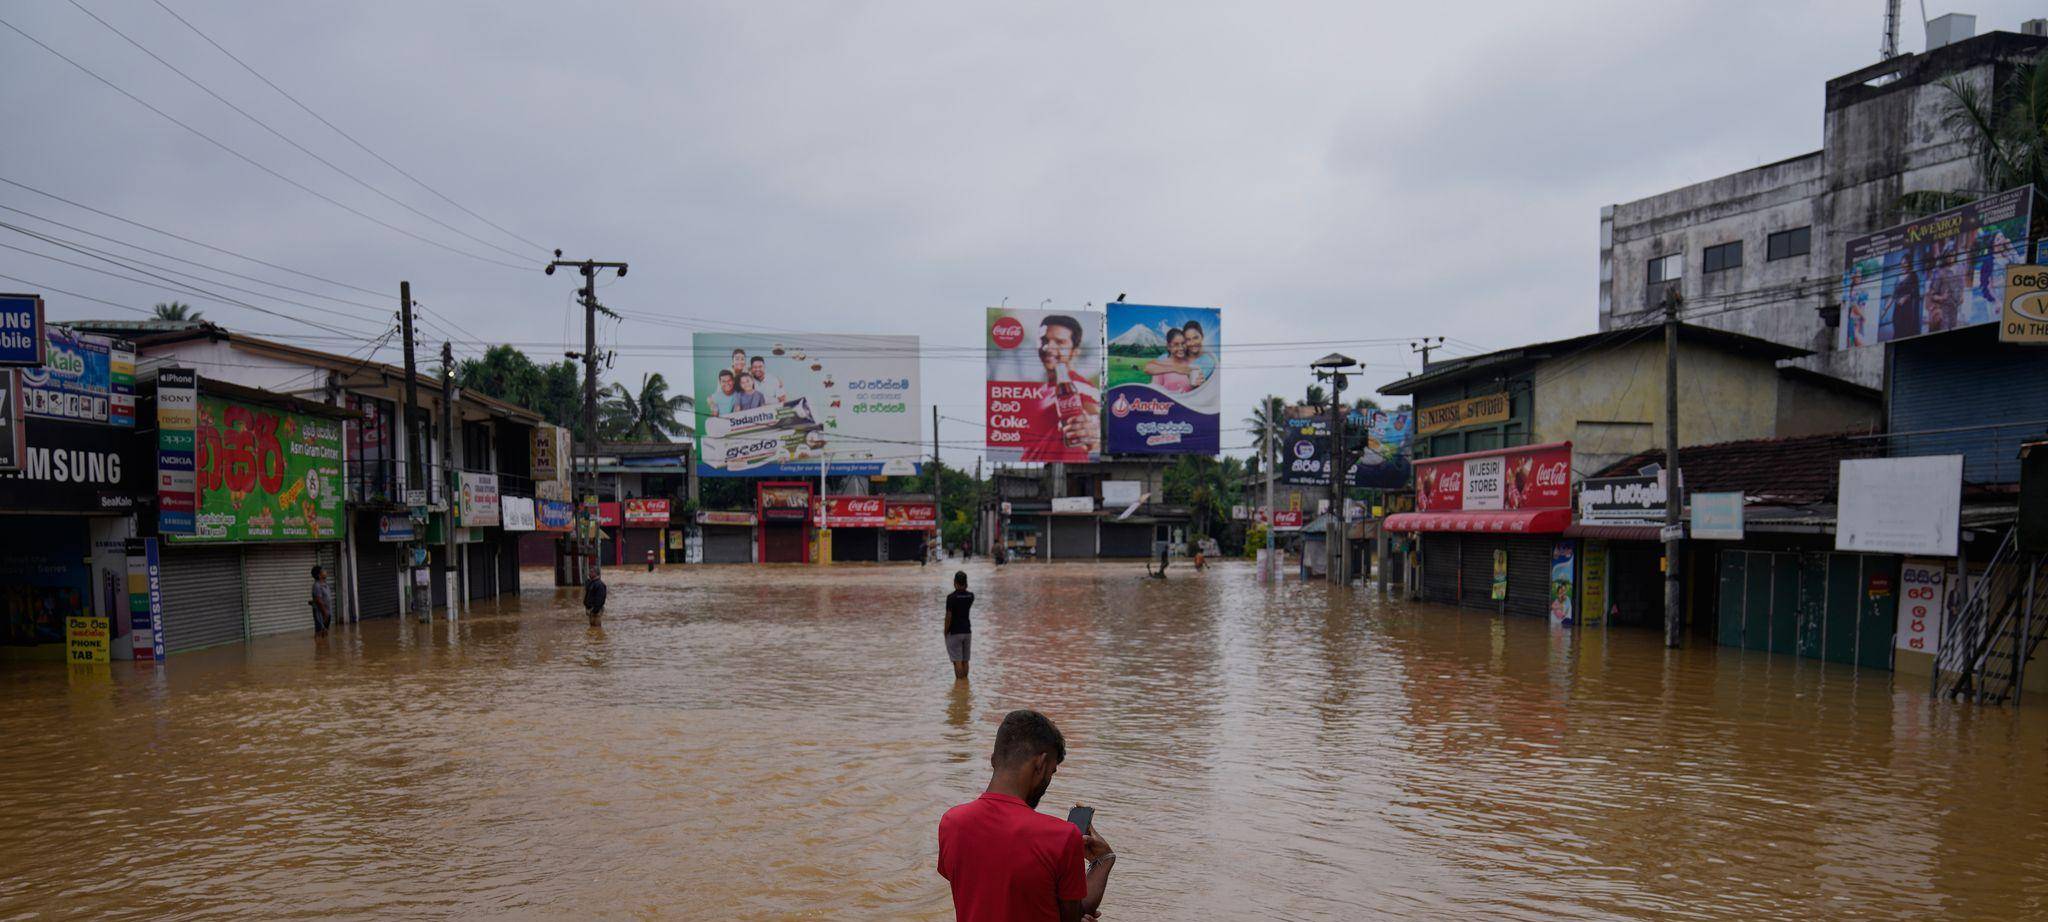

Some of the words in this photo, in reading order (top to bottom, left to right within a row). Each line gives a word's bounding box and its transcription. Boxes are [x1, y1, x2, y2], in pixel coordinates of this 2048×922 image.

[2008, 323, 2025, 335] ON
[0, 332, 31, 348] bile
[166, 374, 192, 383] iPhone
[161, 394, 191, 403] SONY
[991, 387, 1043, 399] BREAK
[1130, 398, 1170, 411] Anchor
[1467, 397, 1504, 418] STUDIO
[161, 415, 190, 424] realme
[729, 412, 774, 427] Sudantha
[991, 415, 1028, 428] Coke
[0, 446, 121, 484] MSUNG
[161, 456, 192, 465] NOKIA
[1469, 462, 1500, 476] WIJESIRI
[1536, 461, 1568, 487] Coca-Cola
[1470, 478, 1498, 493] STORES
[101, 496, 132, 507] SeaKale
[1903, 569, 1942, 584] සිසිර
[149, 564, 165, 656] SAMSUNG
[71, 640, 102, 648] PHONE
[72, 650, 93, 660] TAB
